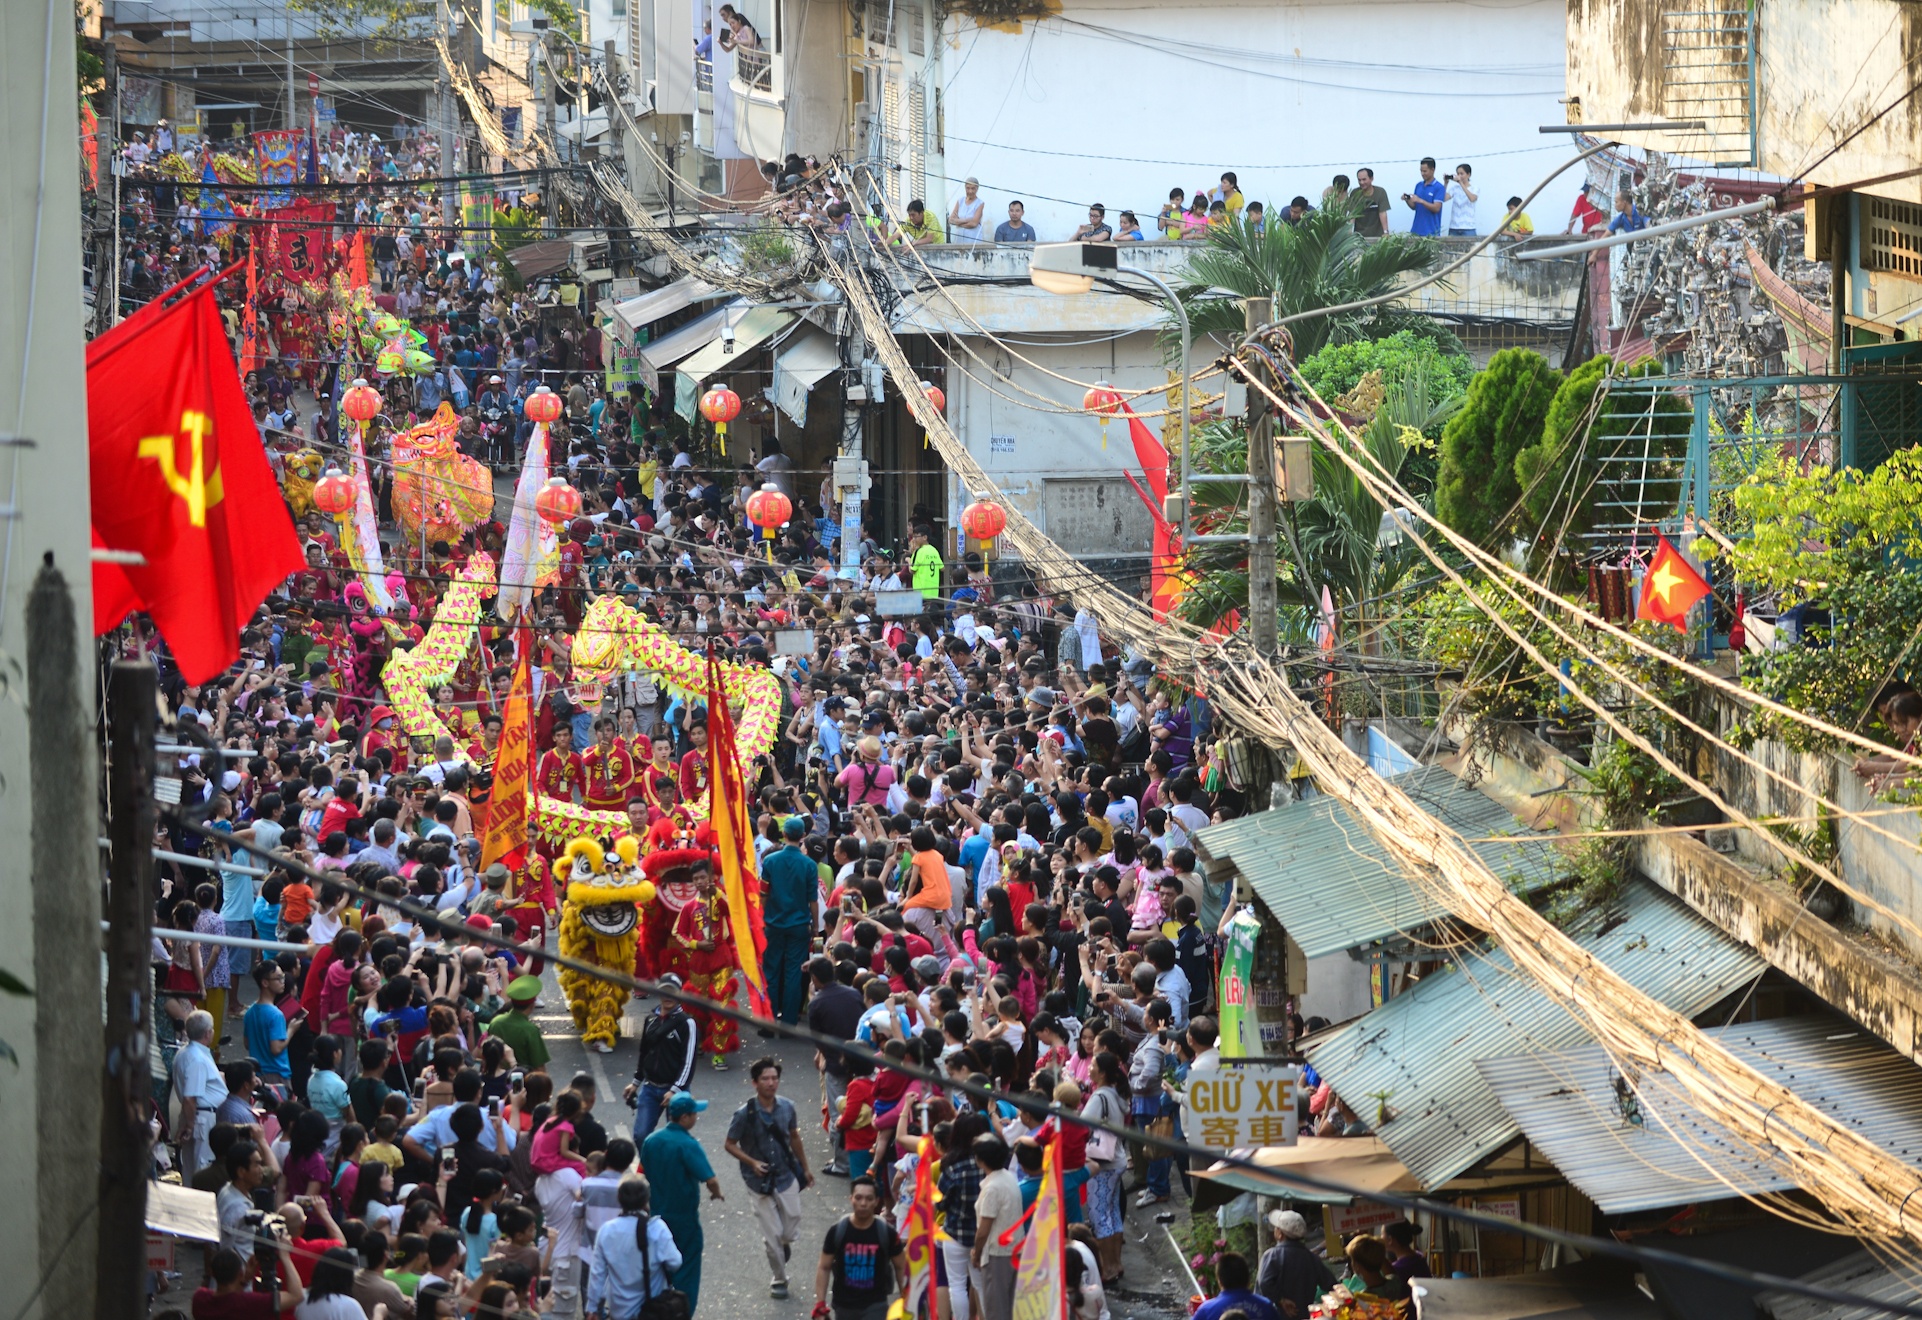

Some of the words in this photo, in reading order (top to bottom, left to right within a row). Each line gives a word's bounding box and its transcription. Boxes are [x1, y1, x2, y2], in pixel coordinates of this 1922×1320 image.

[929, 560, 935, 578] 9
[498, 757, 528, 786] HOA
[1190, 1072, 1245, 1113] GIỮ
[1255, 1080, 1294, 1112] XE
[1201, 1115, 1287, 1148] 寄車
[844, 1242, 880, 1265] OUT
